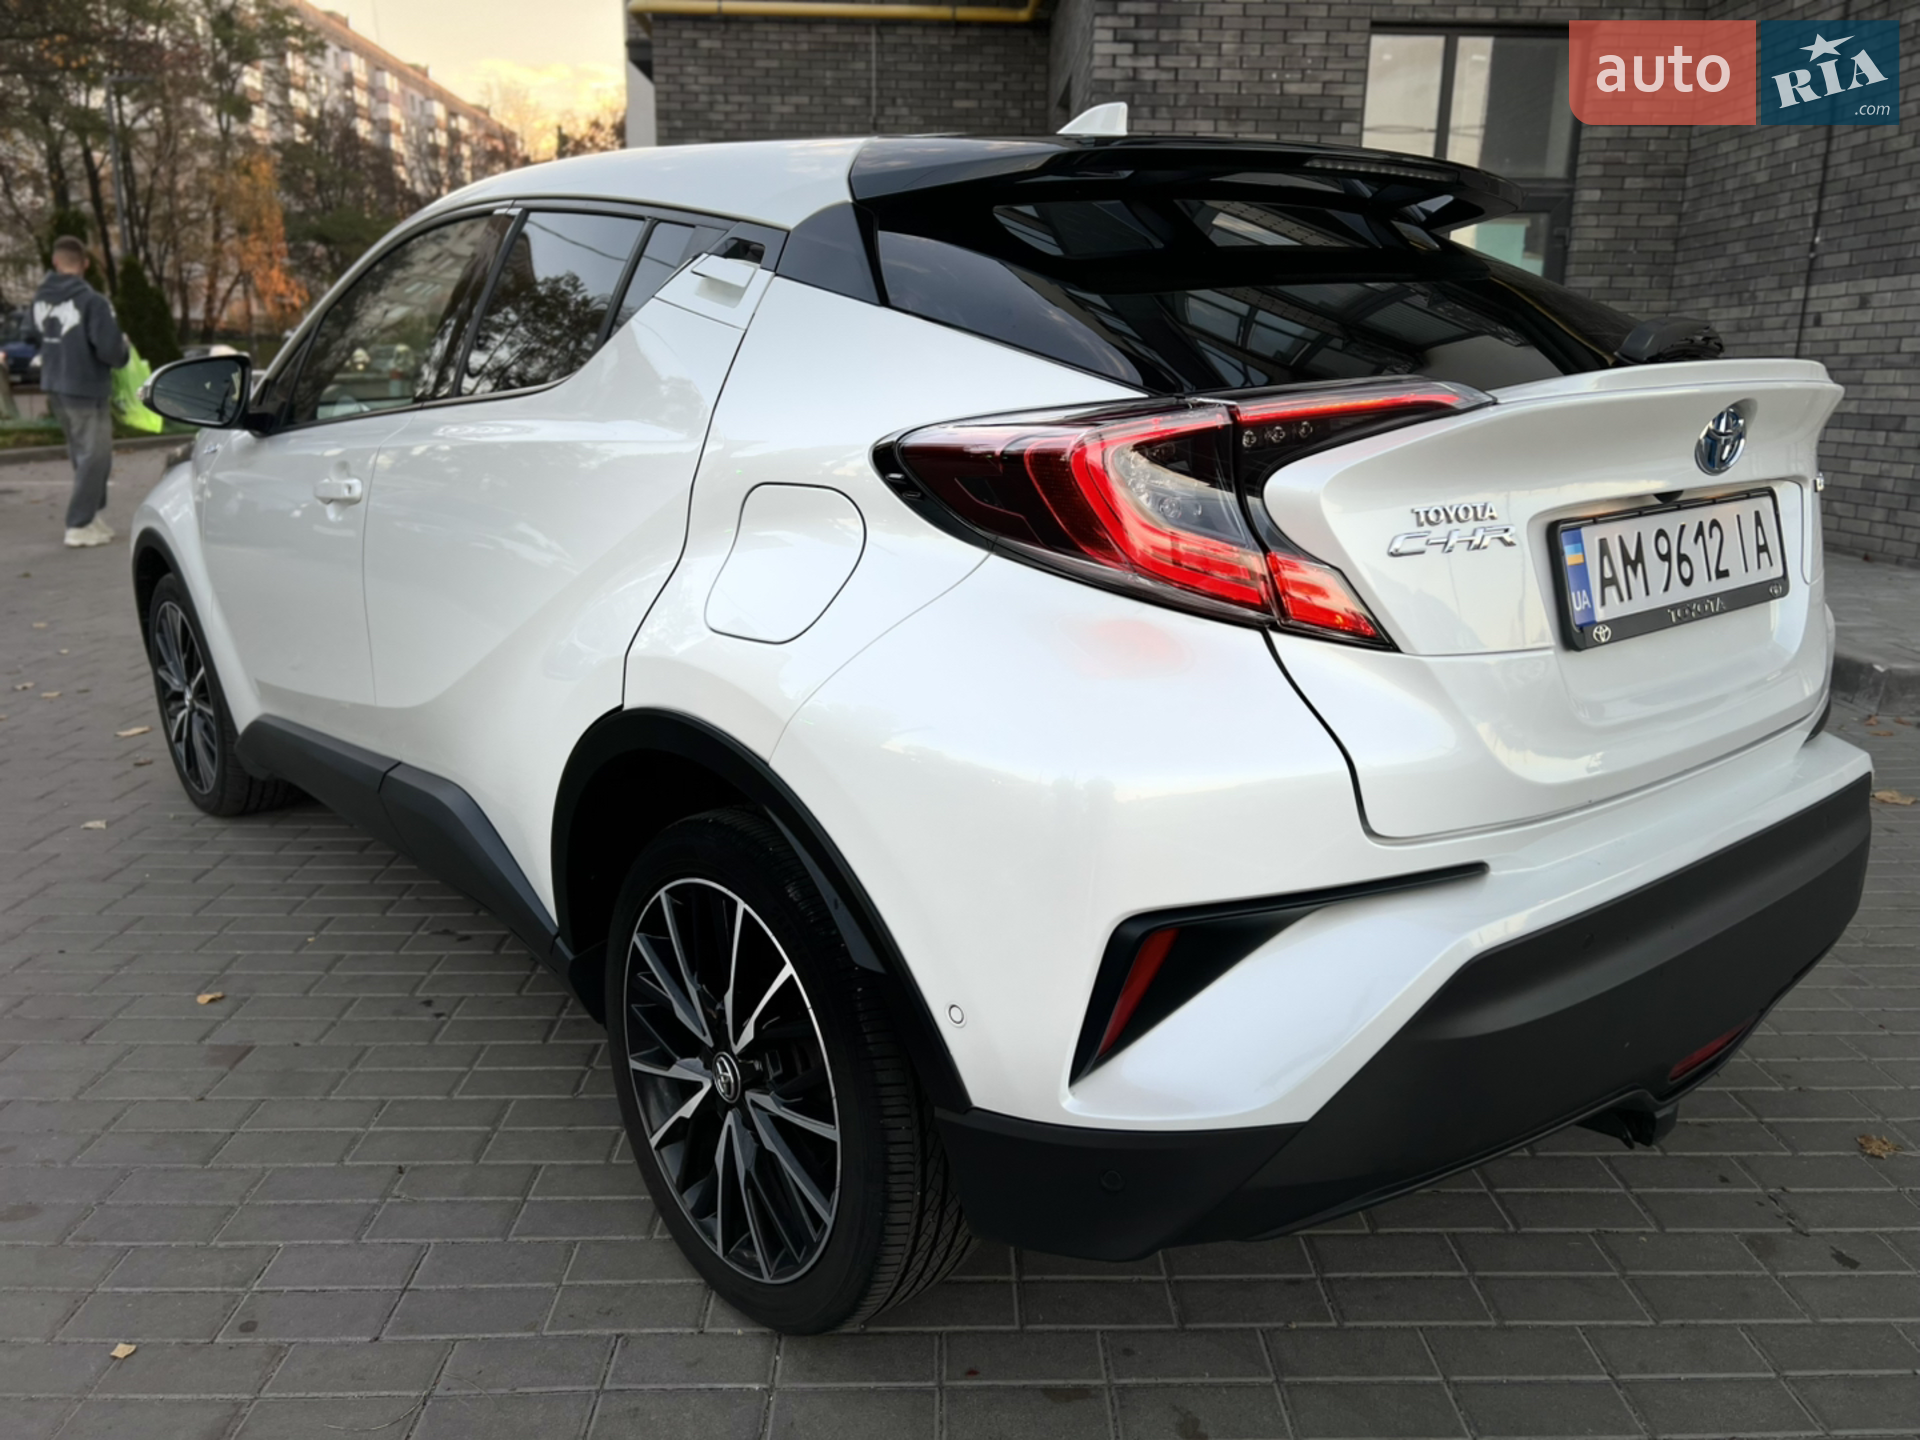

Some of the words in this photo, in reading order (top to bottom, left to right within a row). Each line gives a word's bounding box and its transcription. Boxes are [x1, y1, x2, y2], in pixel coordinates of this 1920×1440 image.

[1411, 502, 1498, 527] TOYOTA
[1387, 524, 1517, 557] C-HR
[1598, 531, 1650, 608] AM
[1654, 517, 1730, 594] 9612
[1571, 590, 1592, 611] UA
[1667, 597, 1727, 623] TOYOTA
